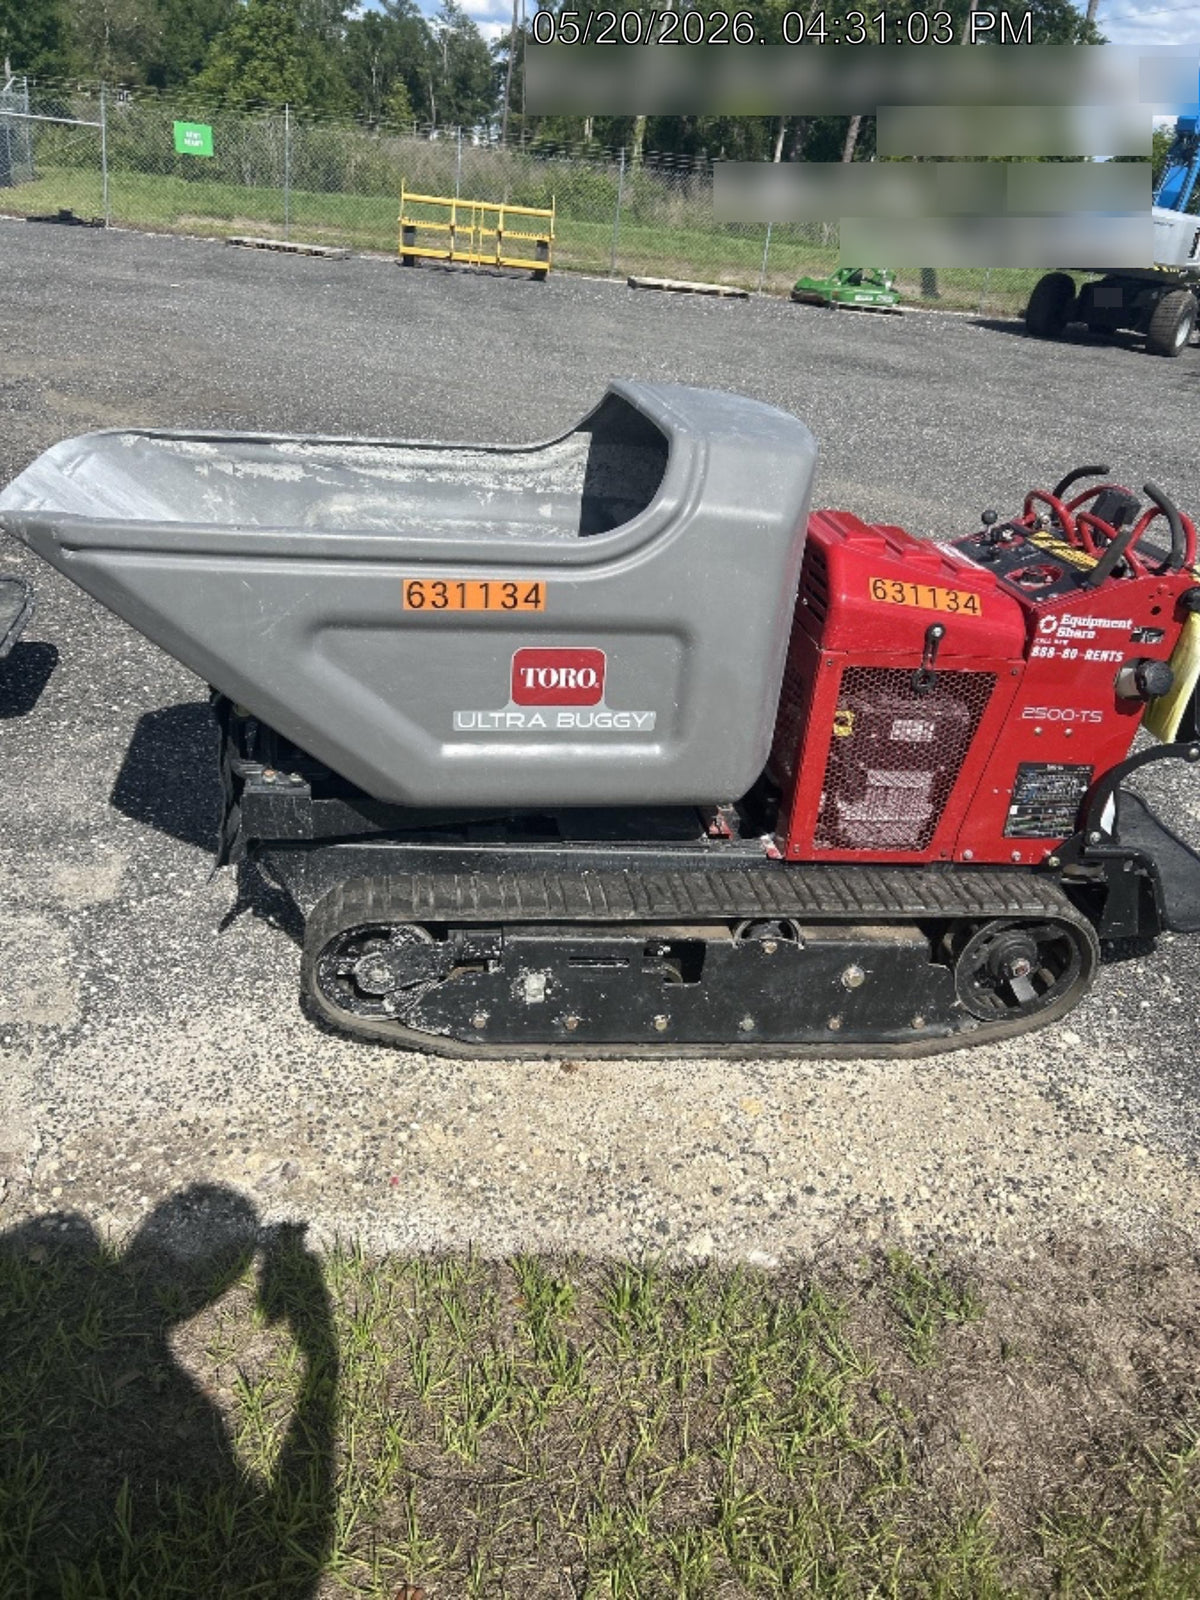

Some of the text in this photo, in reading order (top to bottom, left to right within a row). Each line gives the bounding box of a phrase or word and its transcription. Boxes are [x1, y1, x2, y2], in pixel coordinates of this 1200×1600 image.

[406, 581, 541, 609] 631134
[872, 579, 978, 614] 631134
[1060, 614, 1133, 629] Equipment
[1057, 627, 1096, 639] Share
[520, 668, 596, 688] TORO
[457, 713, 648, 728] ULTRA BUGGY
[1022, 707, 1103, 722] 2500-TS
